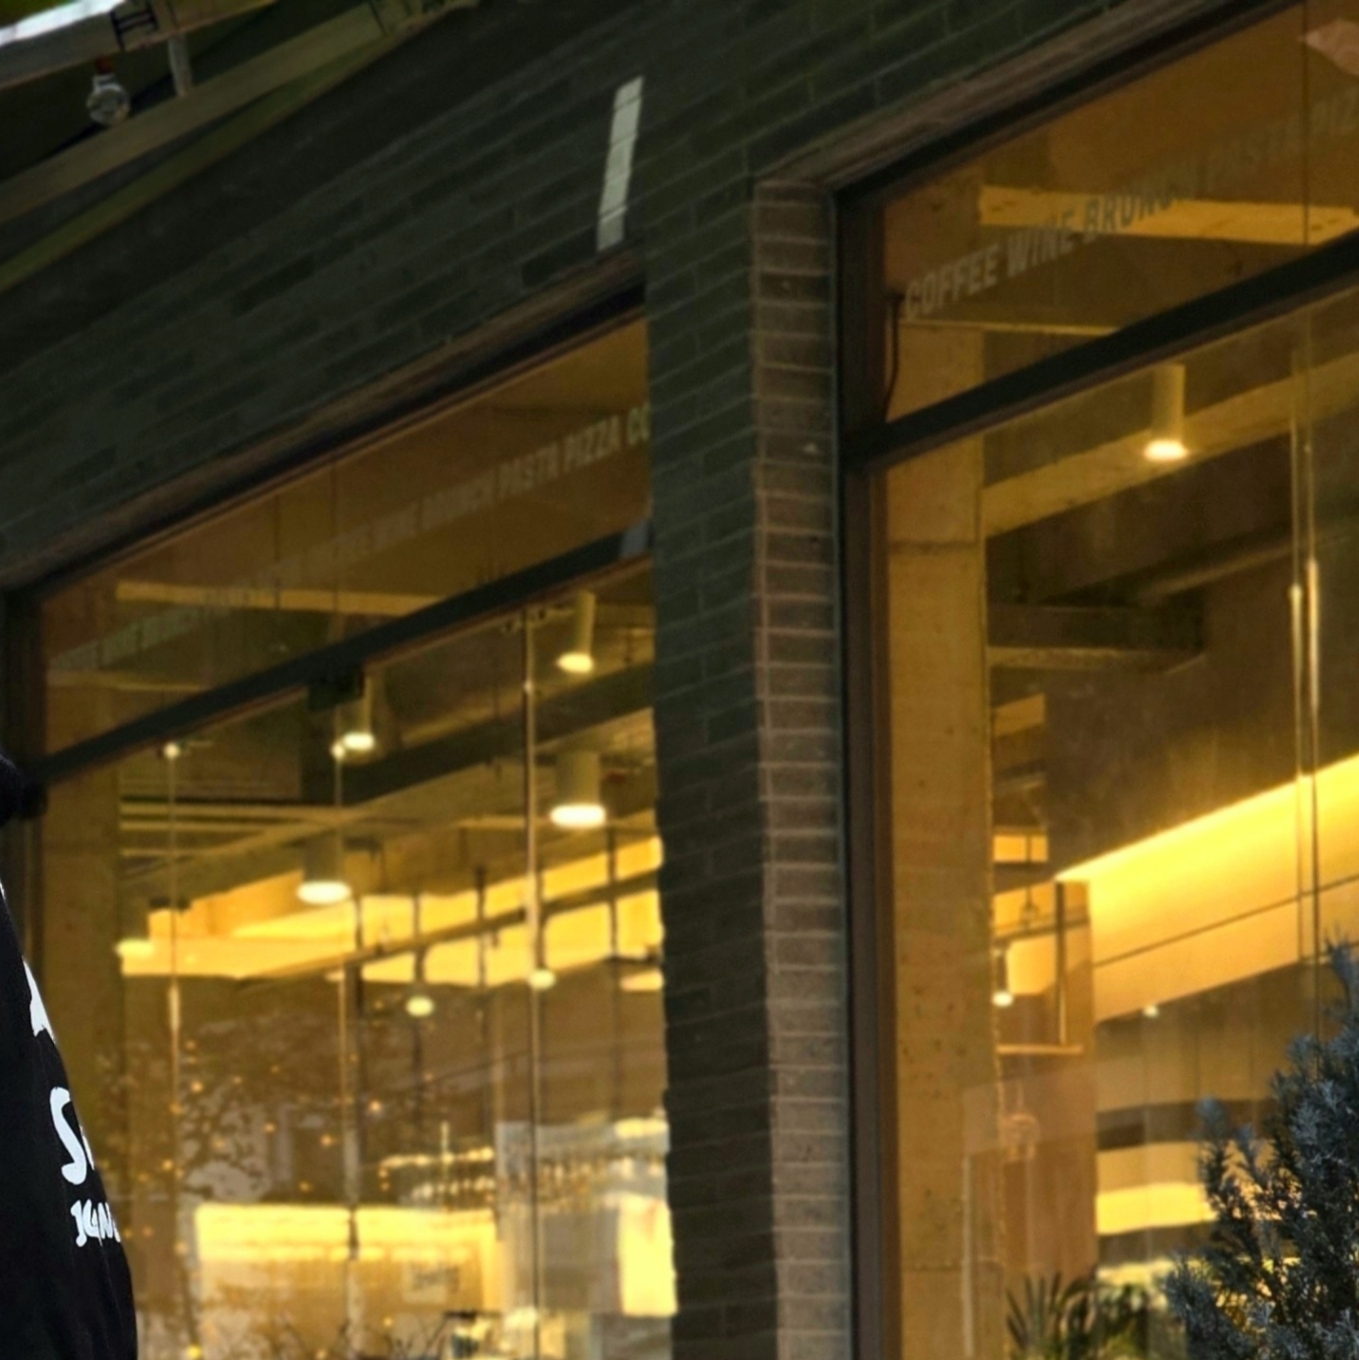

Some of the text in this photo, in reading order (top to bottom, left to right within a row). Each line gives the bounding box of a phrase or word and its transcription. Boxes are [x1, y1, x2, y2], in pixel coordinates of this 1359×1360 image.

[904, 242, 1000, 322] COFFEE
[1004, 206, 1078, 278] WINE
[498, 439, 559, 501] PASTA
[563, 413, 621, 474] PIZZA
